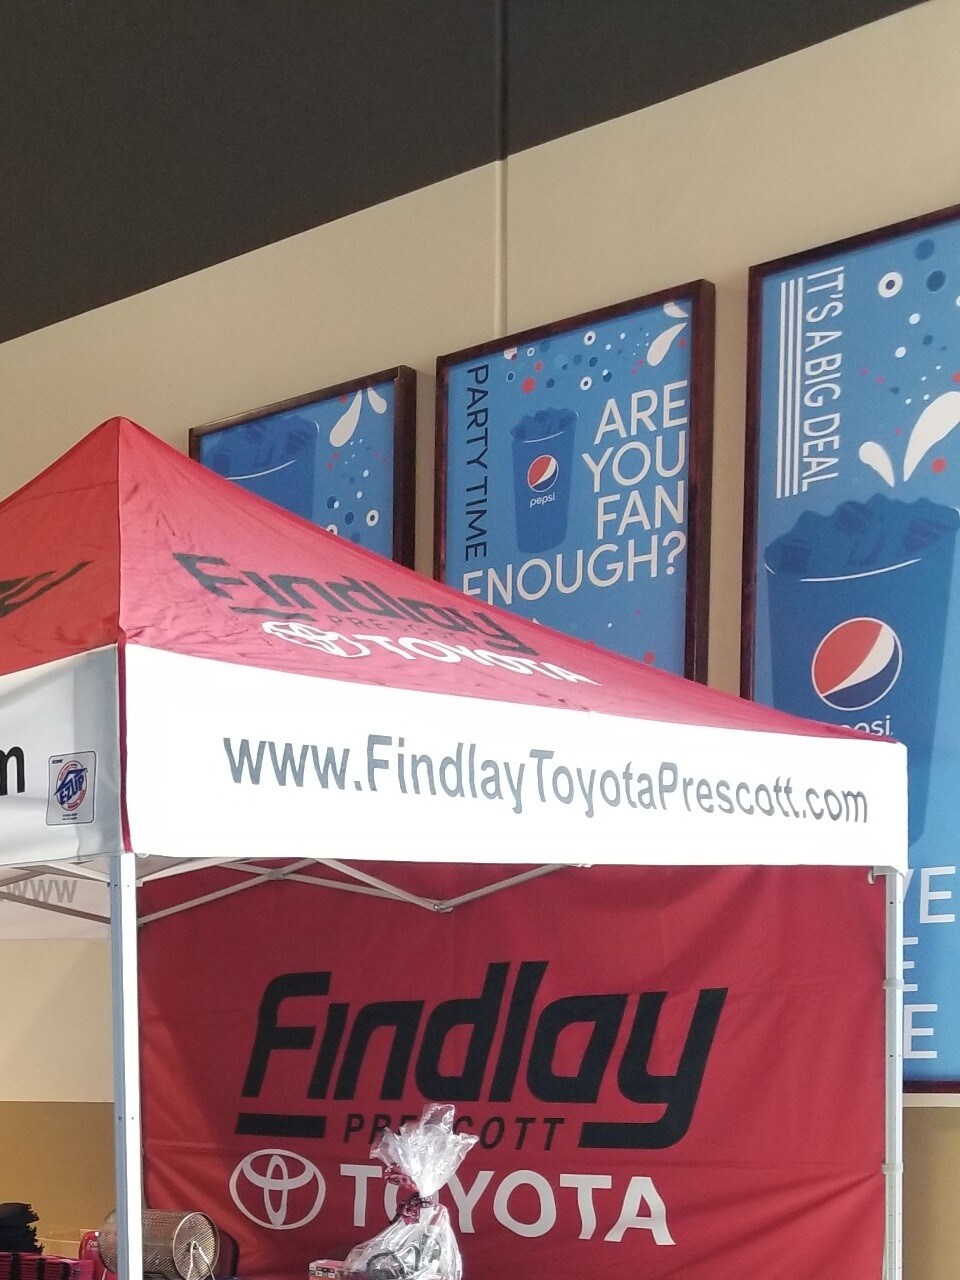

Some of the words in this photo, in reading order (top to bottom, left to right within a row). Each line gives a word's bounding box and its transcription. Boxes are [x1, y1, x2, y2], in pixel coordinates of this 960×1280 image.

[805, 266, 844, 322] IT'S
[805, 331, 842, 352] A
[594, 380, 688, 445] ARE
[804, 353, 842, 408] BIG
[466, 364, 490, 475] PARTY
[802, 412, 841, 492] DEAL
[582, 430, 686, 493] YOU
[465, 479, 488, 562] TIME
[530, 492, 556, 509] pepsi
[597, 481, 685, 540] FAN
[463, 530, 687, 606] ENOUGH?
[173, 552, 540, 656] Findlay
[352, 633, 602, 686] TOYOTA
[223, 735, 868, 824] www.FindlayToyotaPrescott.com
[237, 960, 727, 1149] Findlay
